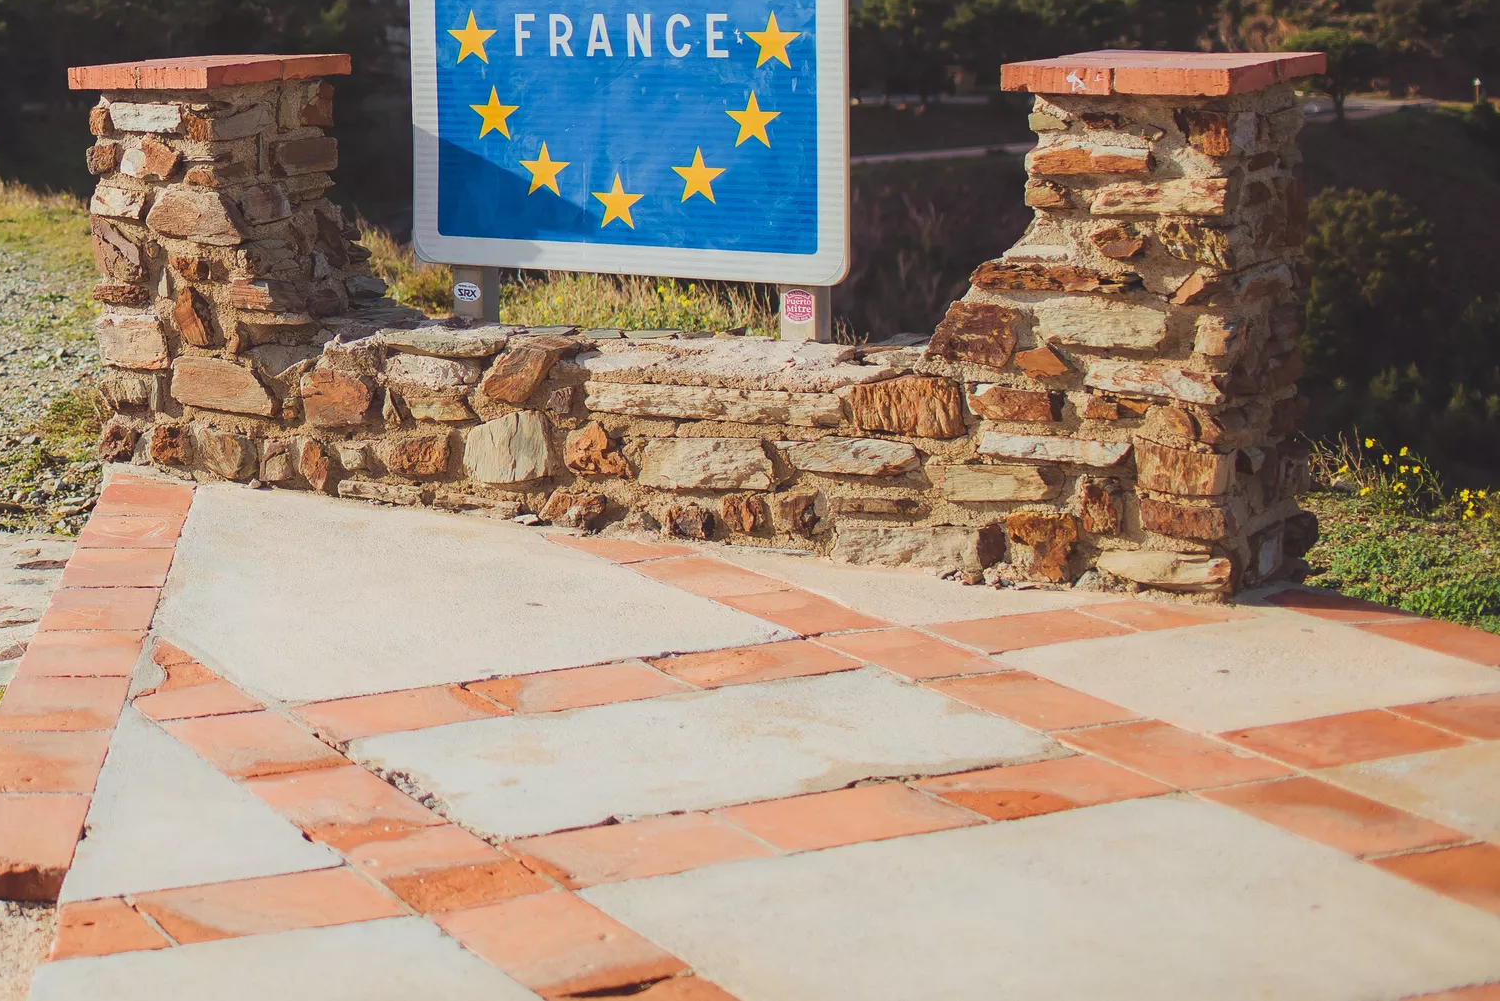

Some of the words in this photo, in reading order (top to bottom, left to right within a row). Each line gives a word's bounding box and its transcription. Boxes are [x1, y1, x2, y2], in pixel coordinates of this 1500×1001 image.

[514, 13, 729, 58] FRANCE
[457, 288, 477, 298] SRX
[786, 304, 811, 312] Mitre
